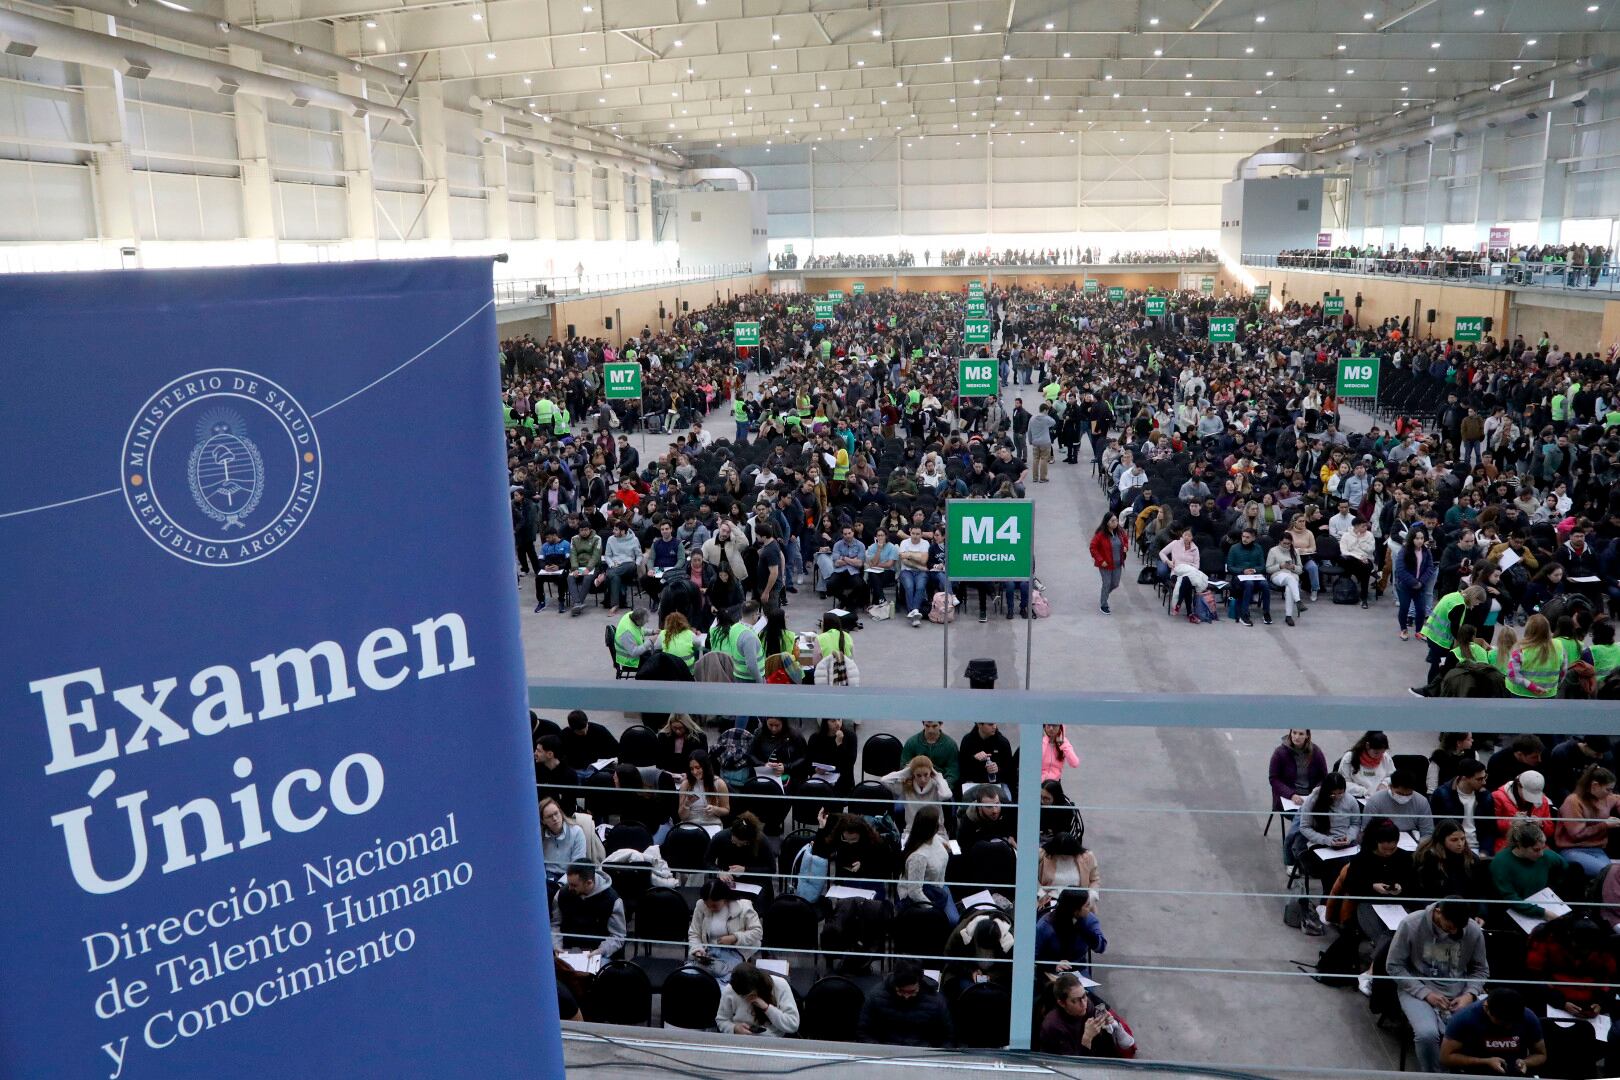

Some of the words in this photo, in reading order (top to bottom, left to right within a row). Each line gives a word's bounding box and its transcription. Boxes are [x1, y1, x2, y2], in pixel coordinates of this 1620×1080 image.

[736, 327, 757, 336] M11
[966, 324, 989, 333] M12
[1210, 323, 1234, 332] M13
[1456, 322, 1481, 331] M14
[609, 369, 634, 383] M7
[965, 366, 992, 380] M8
[1343, 365, 1373, 380] M9
[130, 376, 222, 467] MINISTERIO
[233, 377, 259, 395] DE
[265, 391, 309, 445] SALUD
[134, 492, 229, 559] REPÚBLICA
[239, 469, 315, 557] ARGENTINA
[961, 516, 1021, 544] M4
[963, 553, 1016, 562] MEDICINA
[29, 612, 476, 775] Examen
[50, 752, 385, 894] Único
[82, 877, 295, 973] Dirección
[302, 812, 460, 896] Nacional
[95, 978, 149, 1019] de
[155, 920, 313, 994] Talento
[323, 861, 474, 936] Humano
[101, 1036, 130, 1080] y
[143, 927, 417, 1050] Conocimiento
